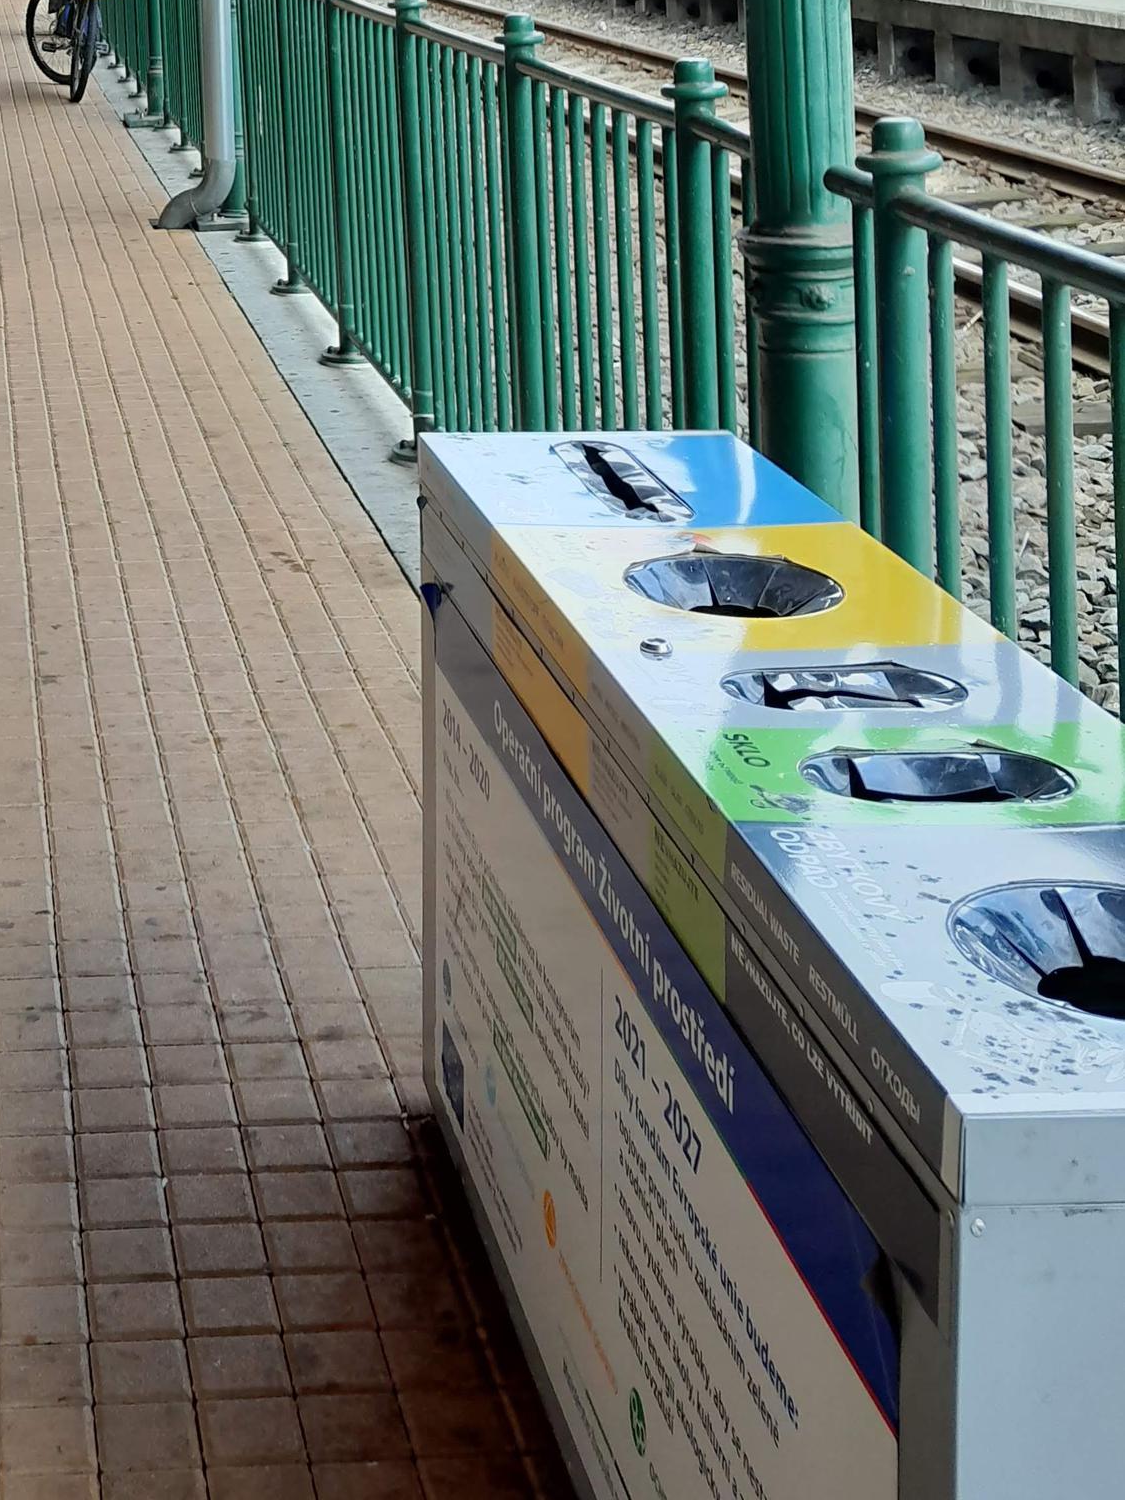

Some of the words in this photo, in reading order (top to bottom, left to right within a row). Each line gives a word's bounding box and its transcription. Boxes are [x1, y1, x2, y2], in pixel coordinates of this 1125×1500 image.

[441, 697, 461, 753] 2014
[468, 742, 490, 802] 2020
[723, 733, 771, 767] SKLO
[493, 698, 541, 798] Operační
[542, 781, 594, 881] program
[597, 858, 649, 974] Životní
[652, 958, 734, 1112] prostředí
[730, 860, 768, 924] RESIDUAL
[769, 911, 799, 966] WASTE
[770, 829, 839, 889] ODPAD
[808, 963, 858, 1045] RESTMÜLL
[614, 994, 646, 1080] 2021
[663, 1080, 701, 1174] 2027
[790, 1020, 805, 1051] CO
[805, 1039, 824, 1079] LZE
[825, 1067, 872, 1144] VYTŘÍDIT
[870, 1045, 920, 1124] ОТХОДЫ
[613, 1056, 633, 1113] Díky
[634, 1095, 671, 1181] fondům
[671, 1165, 717, 1272] Evropské
[718, 1262, 744, 1323] unie
[745, 1307, 798, 1429] budeme:
[618, 1112, 647, 1182] bojovat
[647, 1173, 668, 1222] proti
[668, 1212, 693, 1273] suchu
[693, 1264, 745, 1379] zakládáním
[746, 1370, 779, 1449] zelené
[624, 1158, 655, 1229] vodních
[655, 1220, 678, 1276] ploch
[617, 1271, 646, 1342] vyrábět
[646, 1335, 675, 1404] energii
[617, 1230, 671, 1351] rekonstruovat
[671, 1338, 695, 1407] školy,
[695, 1390, 731, 1483] kulturní
[617, 1296, 643, 1367] kvalitu
[643, 1359, 674, 1435] ovzduší
[618, 1188, 641, 1244] znovu
[641, 1237, 675, 1316] využívat
[675, 1306, 712, 1397] výrobky,
[712, 1385, 730, 1434] aby
[730, 1424, 741, 1459] se
[742, 1450, 768, 1500] nest
